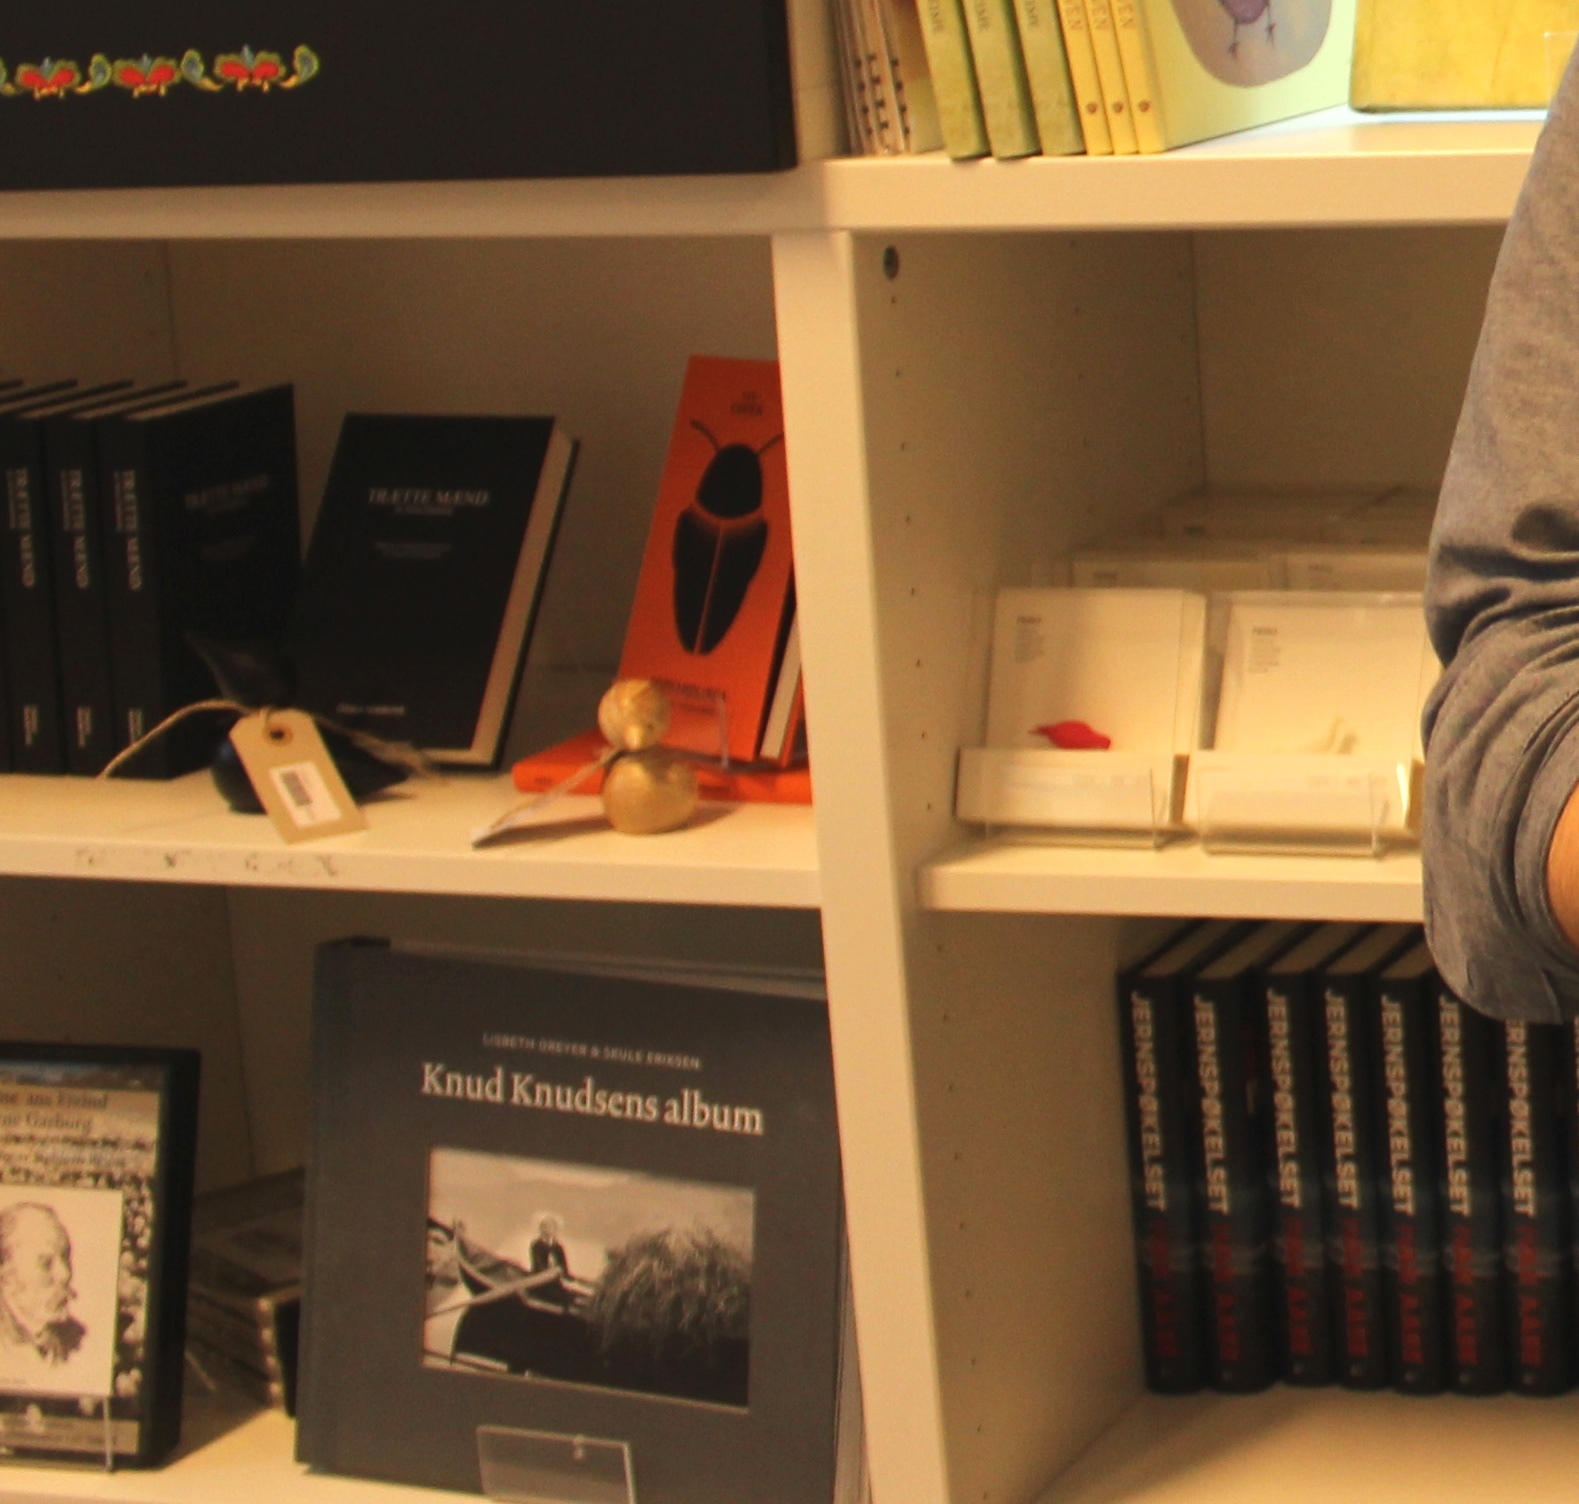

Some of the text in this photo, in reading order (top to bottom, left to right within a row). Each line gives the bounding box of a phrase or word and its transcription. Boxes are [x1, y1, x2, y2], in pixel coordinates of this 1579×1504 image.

[421, 1062, 764, 1137] Knud Knudsens album
[1506, 1018, 1537, 1219] ERNSPØKELSET
